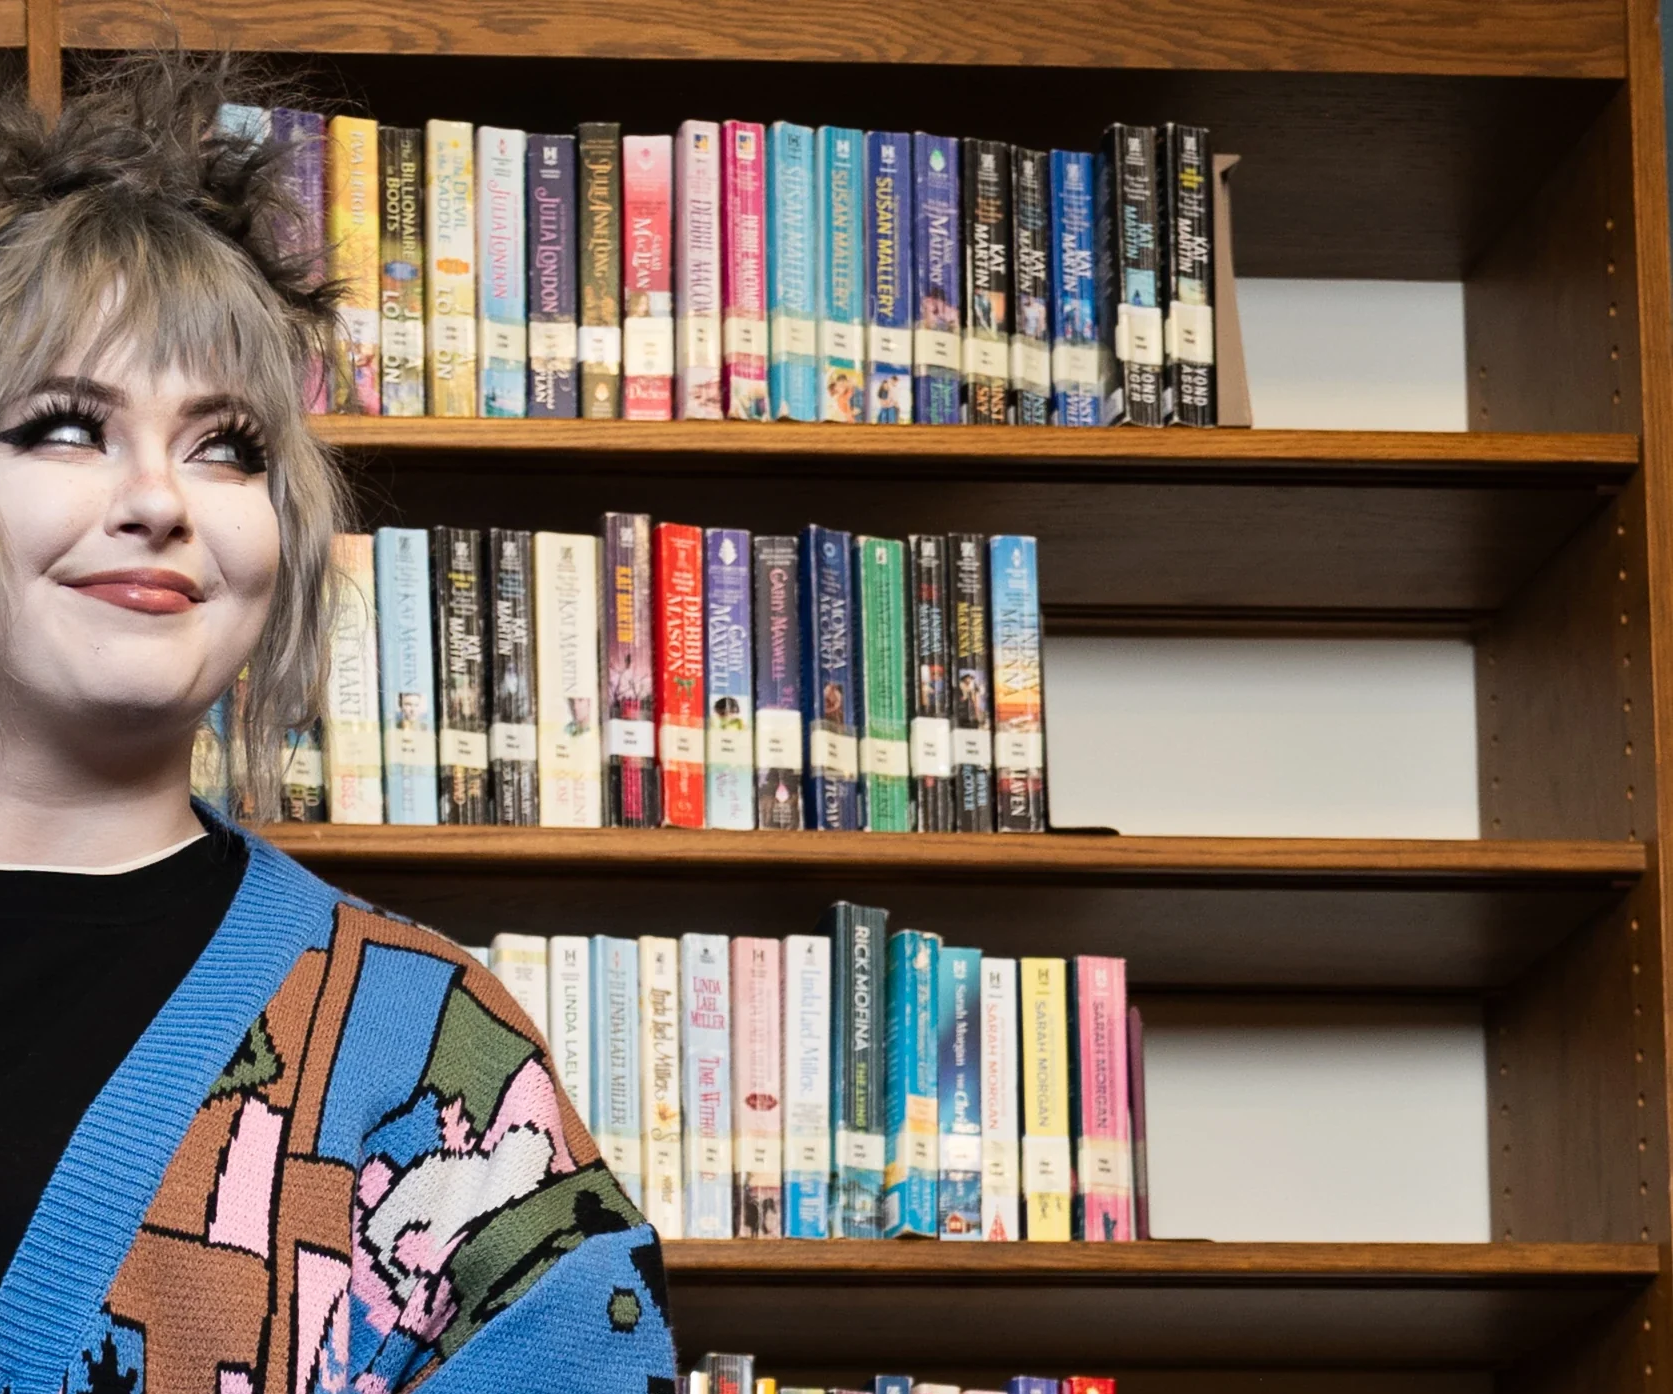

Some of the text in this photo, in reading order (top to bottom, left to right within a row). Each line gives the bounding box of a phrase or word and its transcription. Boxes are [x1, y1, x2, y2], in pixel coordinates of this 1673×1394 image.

[386, 177, 399, 232] BOOTS
[401, 162, 415, 257] BILLIONAIRE
[534, 188, 561, 241] JULIA
[536, 246, 561, 312] LONDON
[876, 177, 893, 316] SUSAN MALLERY
[974, 224, 991, 287] MARTIN
[990, 244, 1004, 274] KAT
[449, 617, 466, 673] MARTIN
[465, 635, 481, 663] KAT
[667, 593, 682, 672] MASON
[684, 595, 700, 677] DEBBIE
[854, 925, 870, 1050] RICK MOFINA
[565, 986, 577, 1077] LINDA LAEL
[1035, 1001, 1049, 1126] SARAH MORGAN
